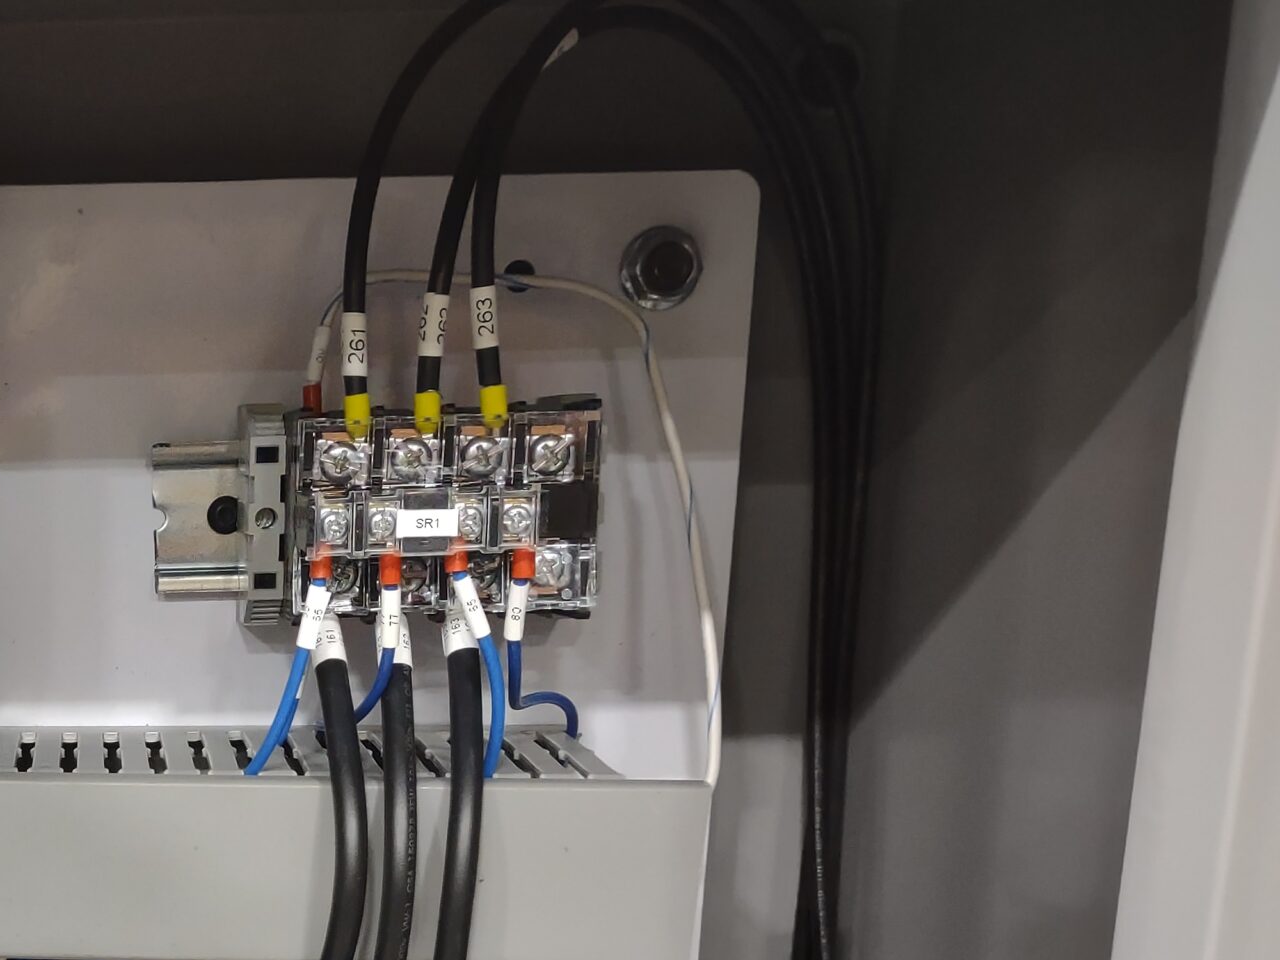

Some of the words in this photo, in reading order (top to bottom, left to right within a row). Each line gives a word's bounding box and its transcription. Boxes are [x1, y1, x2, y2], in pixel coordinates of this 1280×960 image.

[477, 297, 494, 338] 263
[348, 327, 366, 365] 261
[415, 517, 440, 529] SR1
[388, 613, 399, 627] 77
